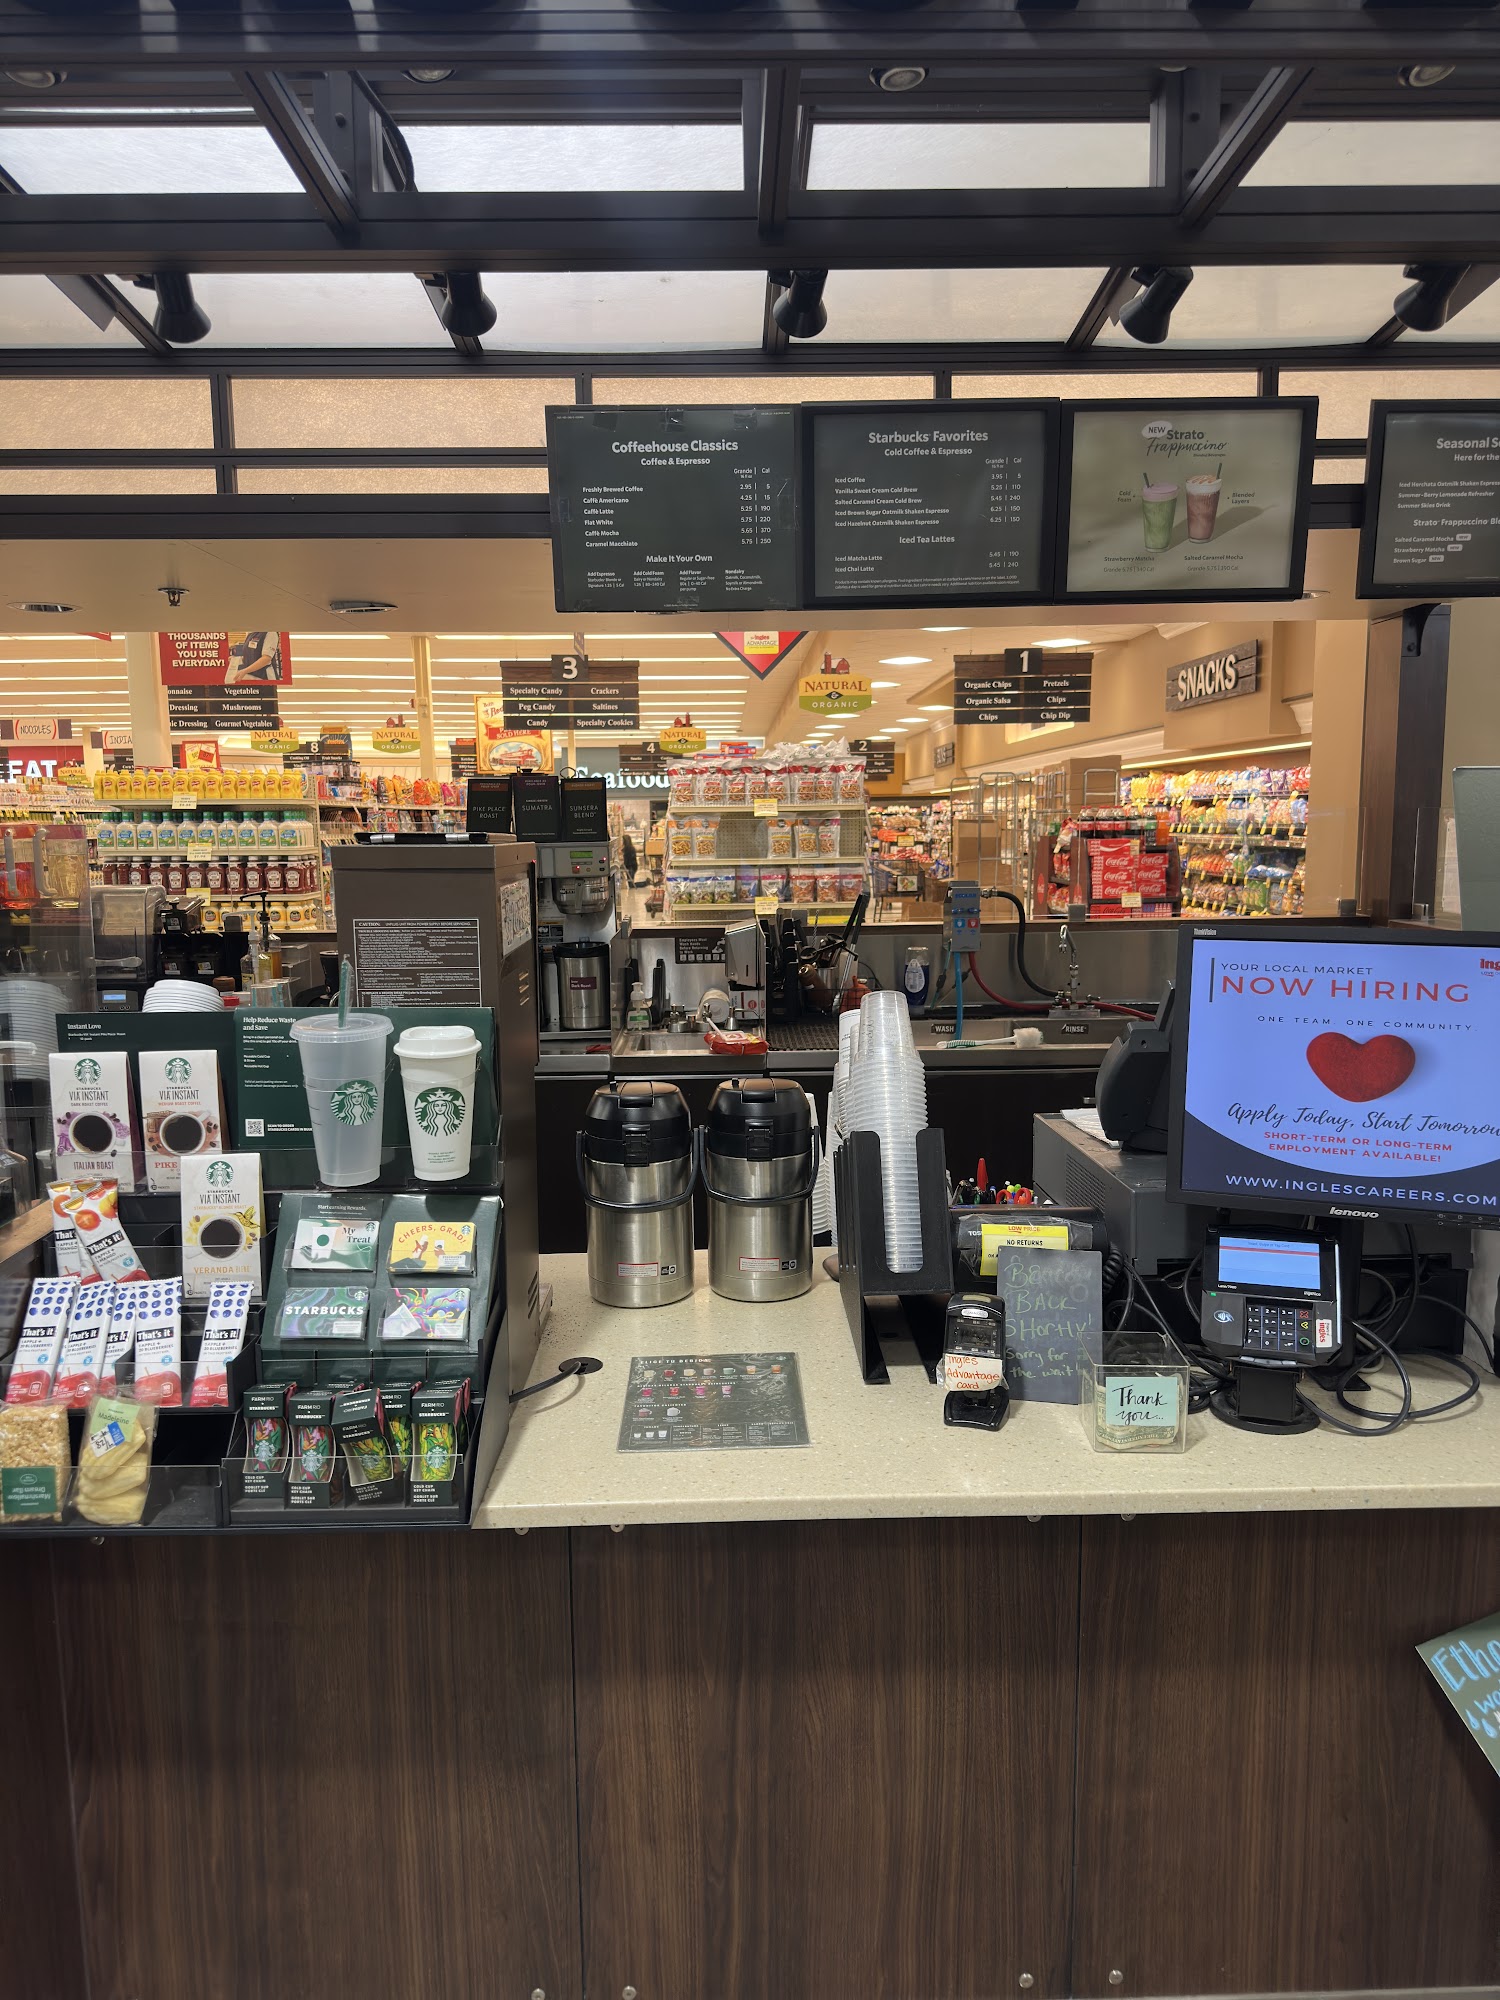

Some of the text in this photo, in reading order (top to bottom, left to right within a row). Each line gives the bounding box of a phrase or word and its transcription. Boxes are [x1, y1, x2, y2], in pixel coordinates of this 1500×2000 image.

[868, 430, 988, 444] Starbucks Favorites
[1167, 430, 1204, 440] Strato
[612, 440, 738, 453] Coffeehouse Classics
[1147, 437, 1227, 458] Frappuccino
[1436, 437, 1490, 449] Seasonal
[938, 447, 972, 456] Espresso
[676, 457, 710, 466] Espresso
[172, 659, 225, 667] EVERYDAY!
[1020, 650, 1029, 672] 1
[562, 657, 578, 679] 3
[1043, 679, 1069, 688] Pretzels
[1177, 654, 1237, 702] SNACKS
[805, 681, 867, 692] NATURAL
[964, 680, 1012, 690] Organic Chips
[224, 688, 259, 696] Vegetables
[966, 697, 992, 706] Organic
[1047, 695, 1066, 704] Chips
[169, 704, 198, 712] Dressing
[518, 704, 531, 712] Peg
[979, 713, 998, 722] Chips
[1041, 711, 1071, 720] Chip Dip
[243, 720, 272, 728] Vegetables
[527, 719, 548, 727] Candy
[21, 725, 51, 734] NOODLES
[310, 742, 319, 753] 8
[0, 760, 57, 782] EAT
[1221, 963, 1373, 975] YOUR LOCAL MARKET
[1221, 976, 1469, 1002] NOW HIRING
[1384, 1021, 1478, 1031] COMMUNITY.
[69, 1090, 108, 1100] VIA INSTANT
[1228, 1103, 1288, 1128] Apply
[1293, 1107, 1355, 1132] Today,
[1362, 1111, 1412, 1131] Start
[1264, 1131, 1346, 1144] SHORT-TERM
[1376, 1140, 1452, 1151] LONG-TERM
[1269, 1143, 1442, 1162] EMPLOYMENT AVAILABLE!
[74, 1162, 94, 1170] ITALIAN
[1226, 1174, 1497, 1206] WWW.INGLESCAREERS.COM
[1329, 1207, 1379, 1218] lenovo
[342, 1227, 356, 1236] My
[398, 1225, 466, 1244] CHEERS, GRAD!
[285, 1306, 364, 1314] STARBUCKS
[138, 1331, 162, 1340] That's
[1006, 1348, 1068, 1367] Sorry for
[947, 1368, 999, 1384] Advantage
[1010, 1365, 1073, 1378] the wait
[1112, 1384, 1167, 1406] Thank
[98, 1412, 129, 1424] Madeleine
